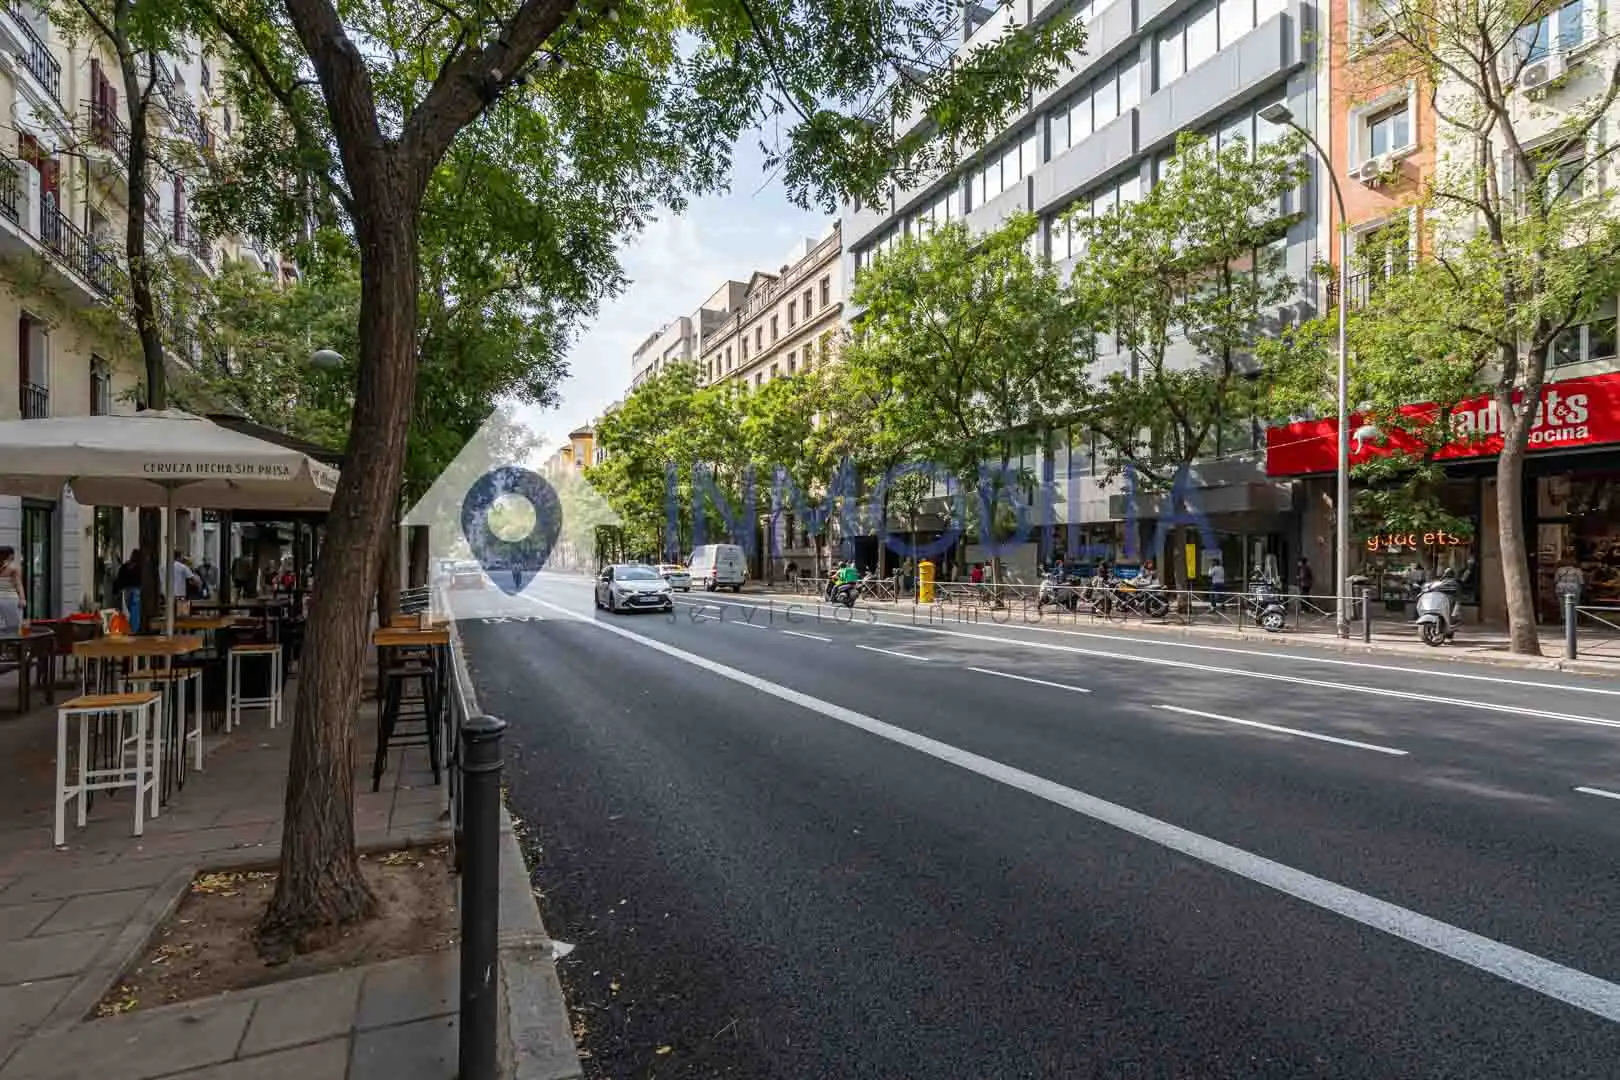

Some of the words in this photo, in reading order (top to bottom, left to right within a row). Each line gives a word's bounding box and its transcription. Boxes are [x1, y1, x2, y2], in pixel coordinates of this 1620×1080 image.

[1448, 390, 1588, 437] adts
[143, 463, 192, 473] CERVEZA
[196, 463, 232, 473] HECHA
